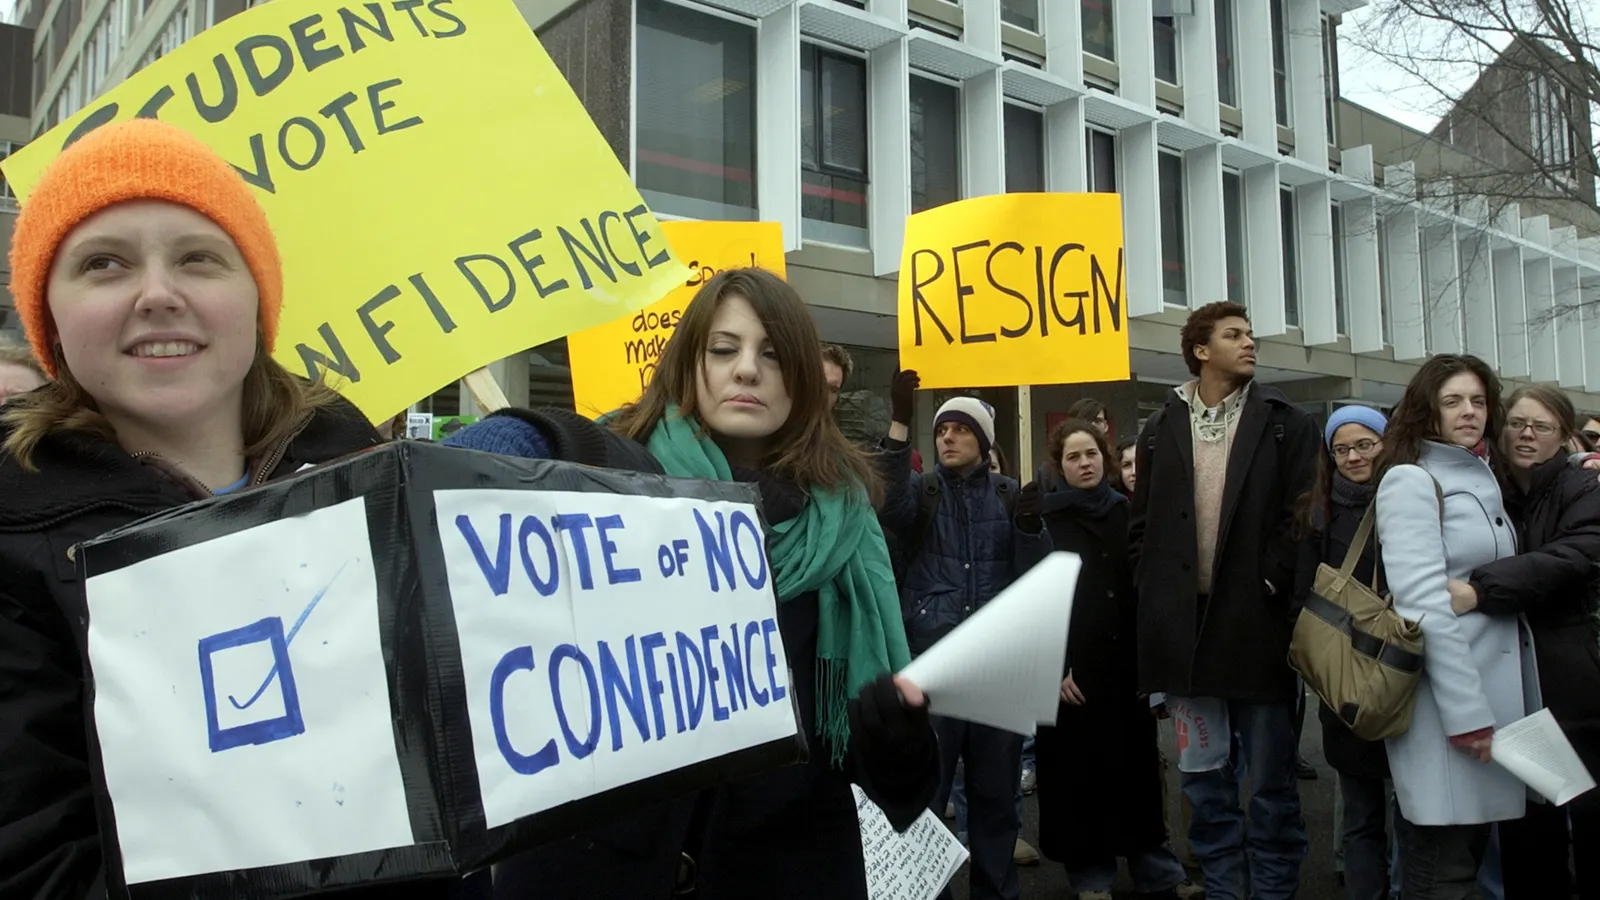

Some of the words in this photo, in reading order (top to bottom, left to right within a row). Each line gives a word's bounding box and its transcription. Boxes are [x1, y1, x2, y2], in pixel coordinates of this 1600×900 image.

[227, 78, 424, 194] VOTE
[294, 203, 671, 385] NFIDENCE
[911, 239, 1123, 346] RESIGN
[632, 309, 683, 333] does
[624, 334, 669, 365] mak
[455, 512, 642, 597] VOTE
[657, 538, 690, 579] OF
[692, 507, 767, 593] NO
[489, 617, 786, 776] CONFIDENCE
[897, 848, 916, 871] FROM
[934, 832, 947, 849] THE
[869, 841, 911, 888] TREATMENT
[884, 872, 899, 889] THE
[932, 856, 951, 886] LARRY
